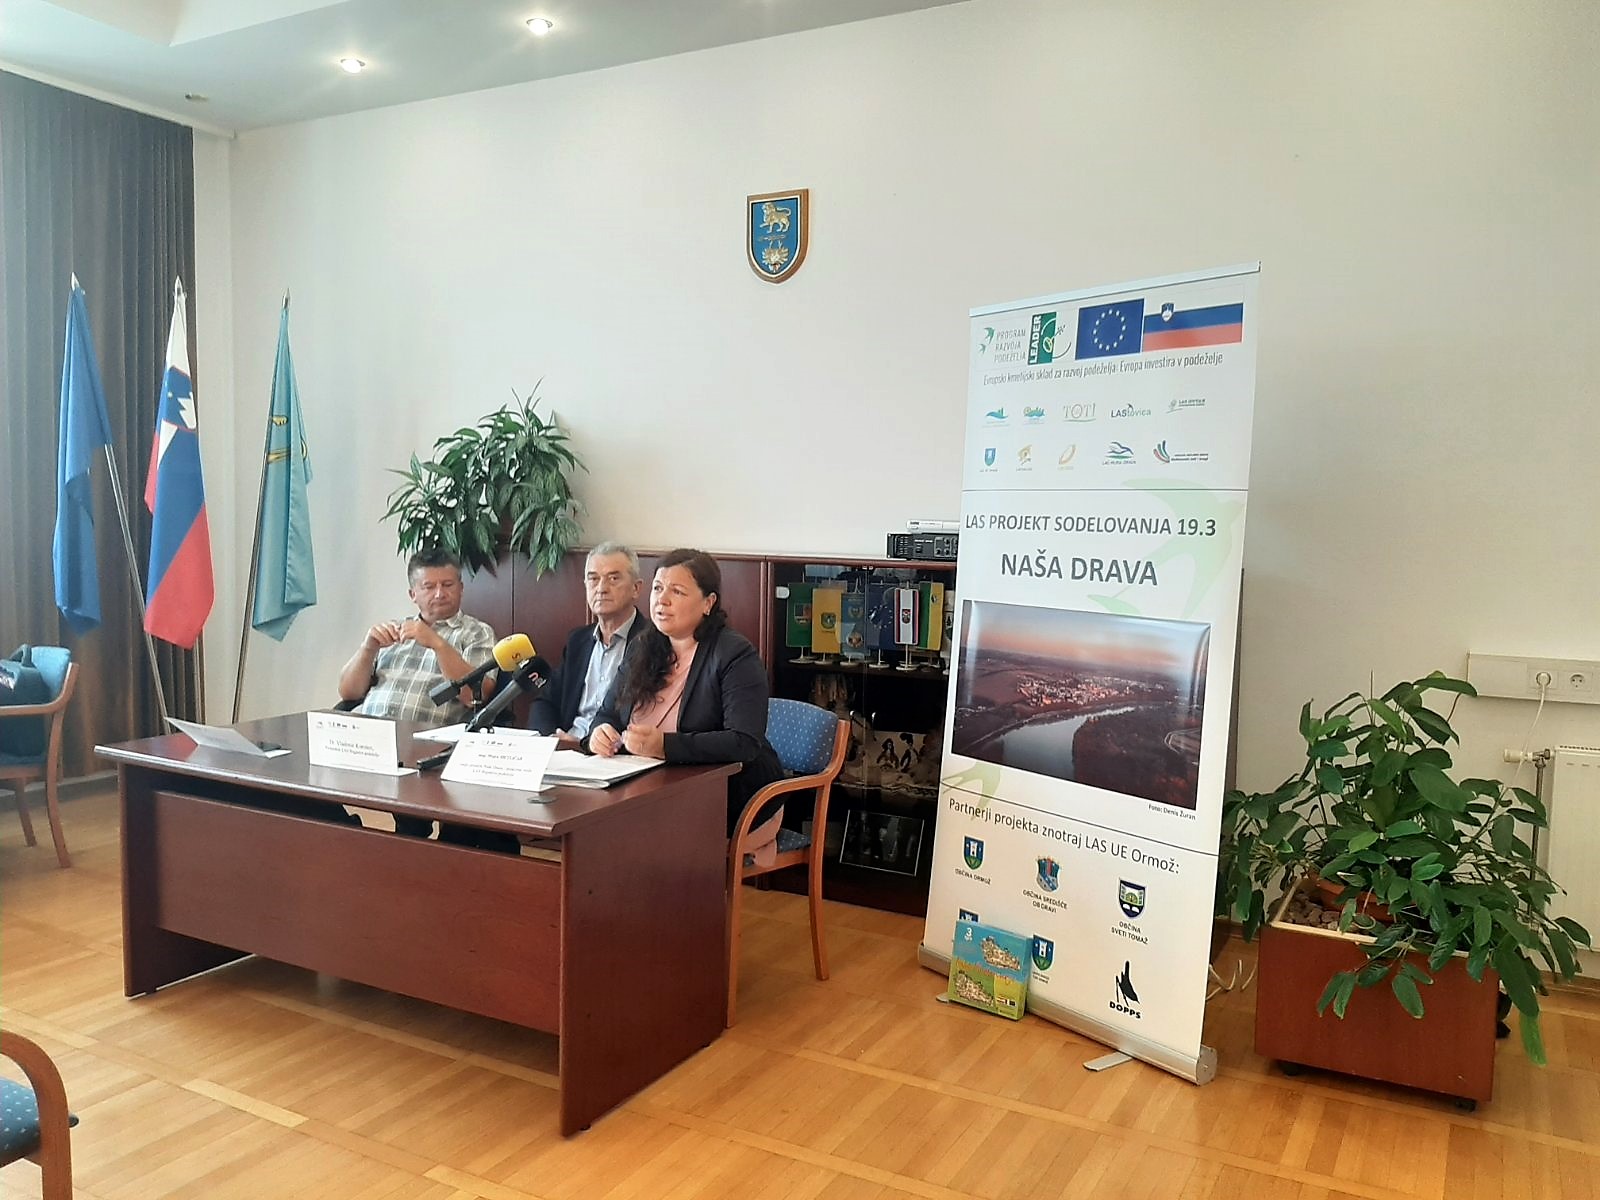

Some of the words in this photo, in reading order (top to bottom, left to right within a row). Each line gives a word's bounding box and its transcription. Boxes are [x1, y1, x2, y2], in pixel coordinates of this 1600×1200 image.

[996, 329, 1026, 340] PROGRAM
[1029, 315, 1042, 364] LEADER
[995, 341, 1021, 351] RAZVOJA
[1036, 369, 1053, 380] sklad
[1054, 370, 1062, 378] za
[1063, 366, 1082, 379] razvoj
[1119, 359, 1143, 373] Evropa
[1144, 356, 1175, 370] investira
[1178, 358, 1183, 366] v
[1184, 351, 1223, 368] podeželje
[965, 514, 986, 530] LAS
[989, 515, 1051, 531] PROJEKT
[1054, 515, 1172, 535] SODELOVANJA
[1177, 518, 1217, 537] 19.3
[1001, 549, 1063, 580] NAŠA
[1070, 557, 1159, 586] DRAVA
[1180, 810, 1196, 820] Žuran
[949, 797, 992, 822] Partnerji
[994, 812, 1039, 834] projekta
[1042, 825, 1083, 849] znotraj
[1085, 835, 1107, 853] LAS
[1111, 842, 1128, 859] UE
[1131, 848, 1180, 874] Ormož:
[955, 868, 973, 879] OBČINA
[973, 873, 991, 885] ORMOŽ
[1022, 889, 1042, 900] OBČINA
[1042, 895, 1068, 909] SREDIŠČE
[1032, 900, 1041, 908] OB
[1040, 902, 1057, 913] DRAVI
[966, 927, 973, 937] 3
[1111, 926, 1127, 937] SVETI
[1128, 932, 1149, 944] TOMAŽ
[1118, 920, 1141, 934] OBČINA
[1109, 1001, 1141, 1019] DOPPS
